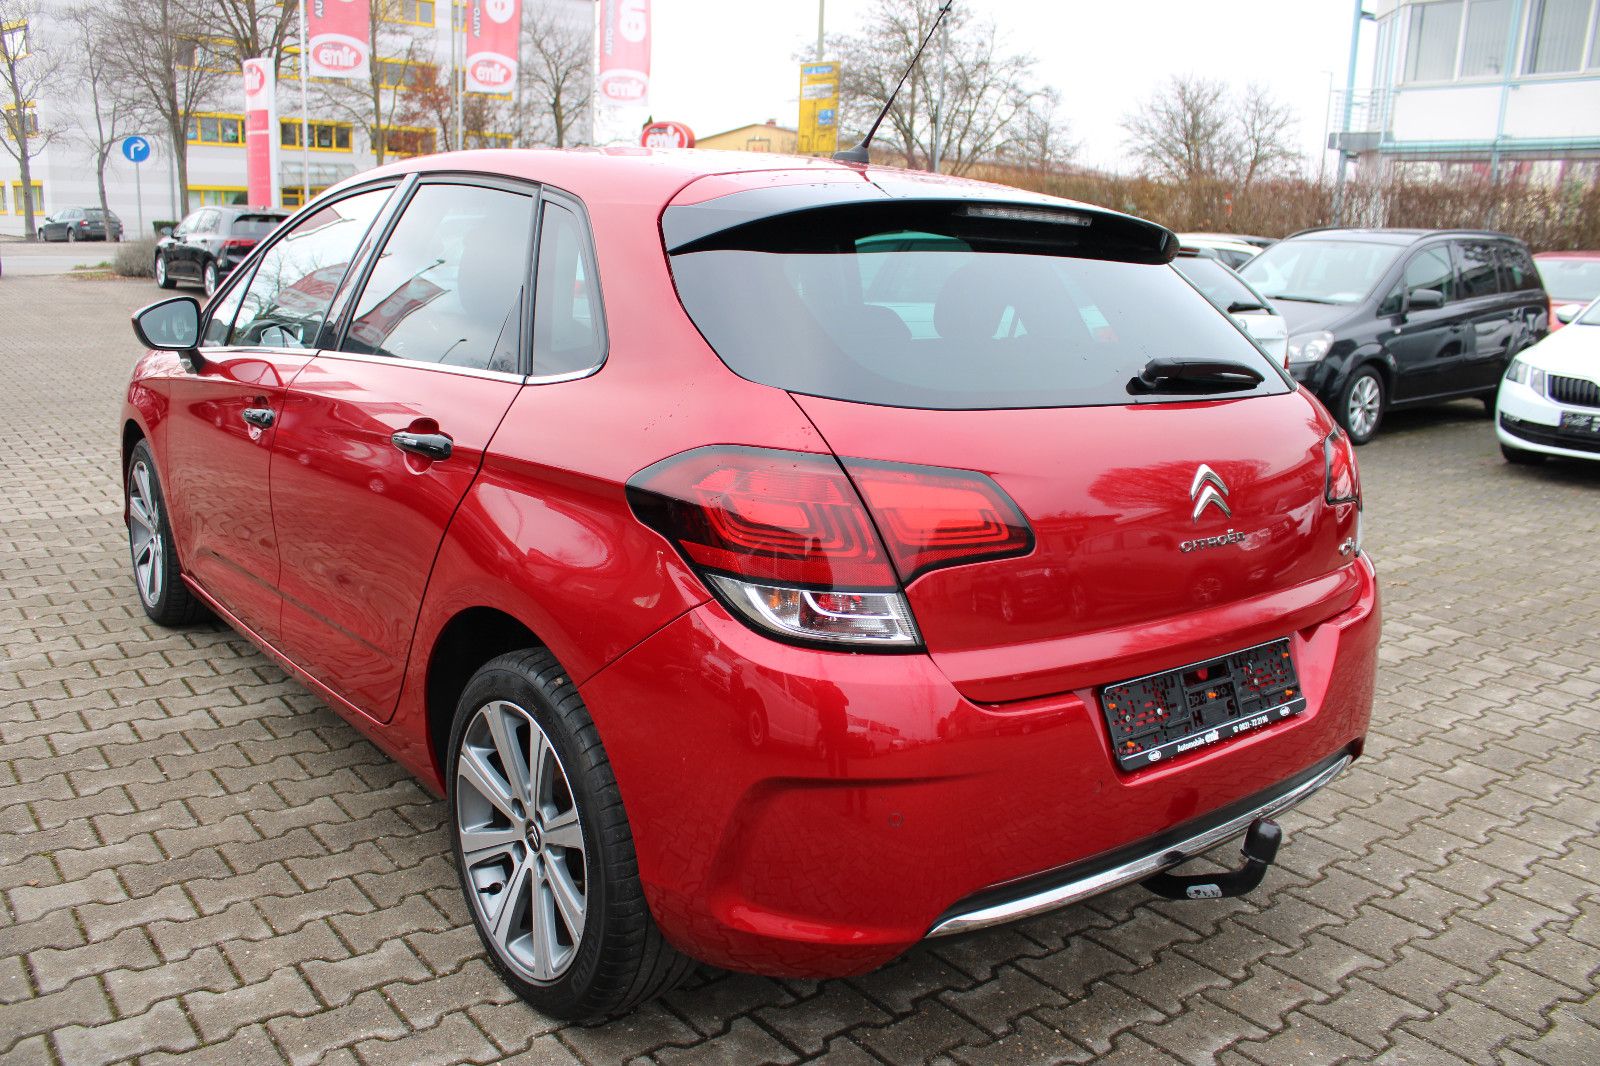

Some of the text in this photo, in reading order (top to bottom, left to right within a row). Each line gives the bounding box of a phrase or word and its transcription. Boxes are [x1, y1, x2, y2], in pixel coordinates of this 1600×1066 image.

[319, 46, 357, 67] emir
[476, 63, 507, 82] emir
[607, 79, 644, 97] emir
[647, 125, 680, 148] emir
[1179, 528, 1246, 553] CITROËN
[1177, 737, 1205, 752] Automobile
